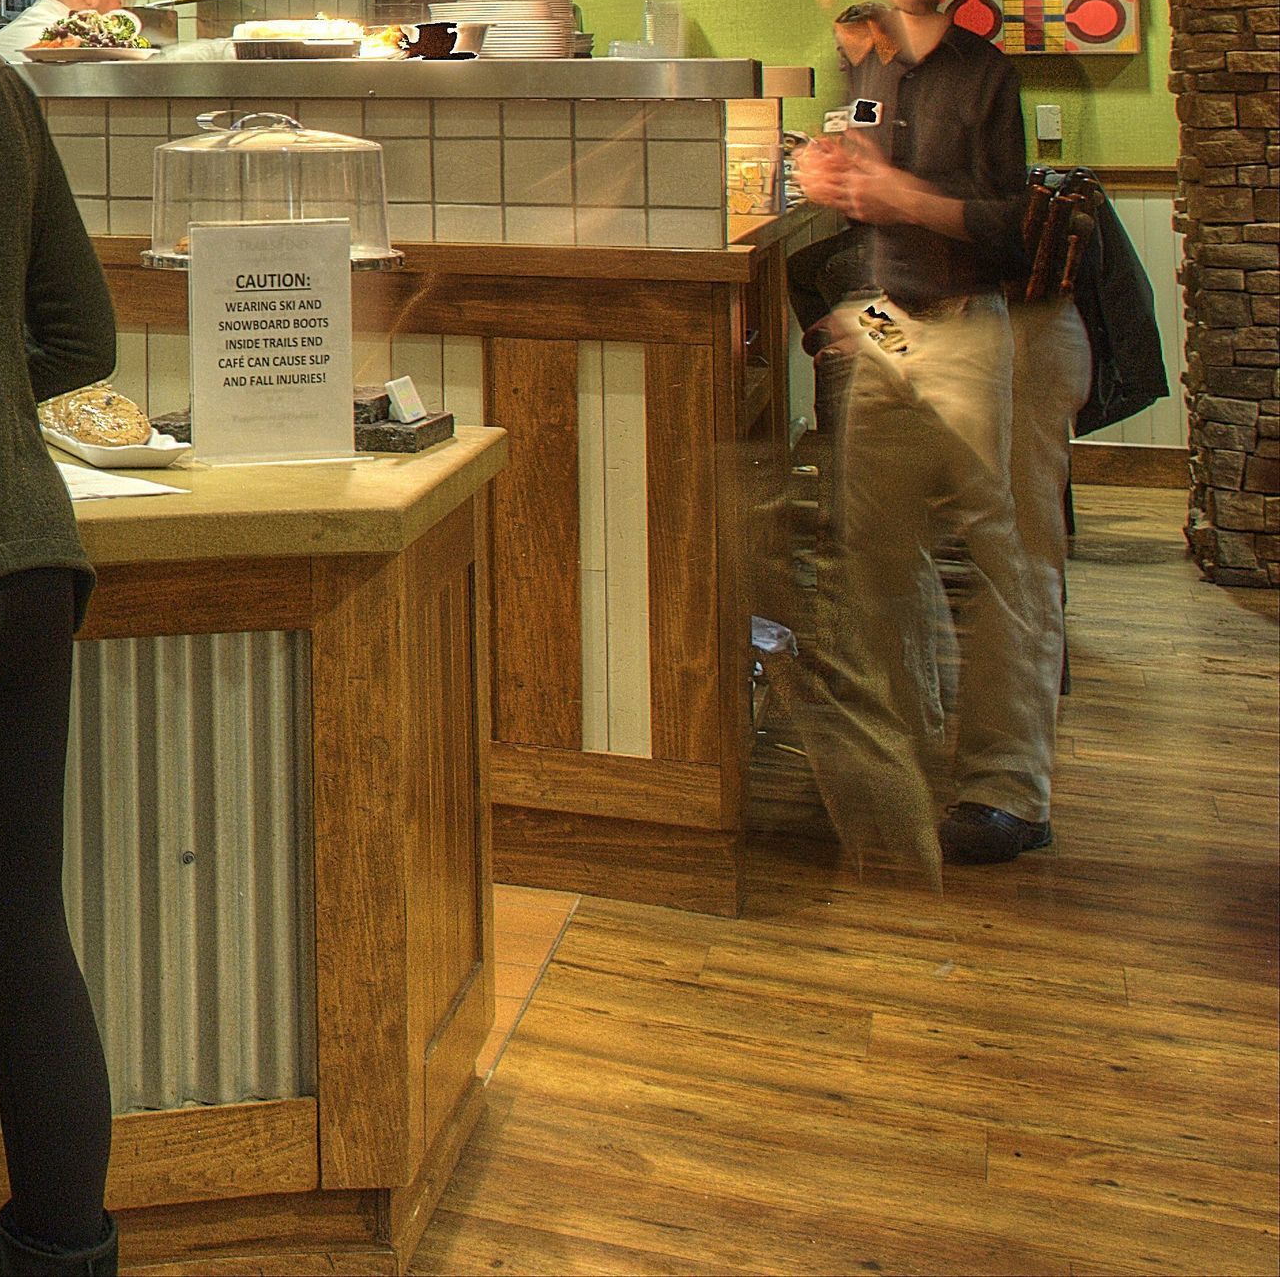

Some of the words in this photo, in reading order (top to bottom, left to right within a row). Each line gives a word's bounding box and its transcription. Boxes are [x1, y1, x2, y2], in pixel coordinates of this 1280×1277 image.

[235, 273, 311, 290] CAUTION:
[225, 300, 276, 312] WEARING
[279, 300, 296, 311] SKI
[298, 299, 322, 311] AND
[218, 318, 290, 332] SNOWBOARD
[292, 317, 329, 329] BOOTS
[225, 339, 261, 350] INSIDE
[262, 337, 298, 349] TRAILS
[300, 336, 323, 348] END
[218, 355, 245, 369] CAFÉ
[247, 356, 271, 368] CAN
[272, 355, 307, 367] CAUSE
[309, 354, 330, 366] SLIP
[223, 375, 247, 387] AND
[249, 374, 274, 386] FALL
[276, 373, 327, 385] INJURIES!
